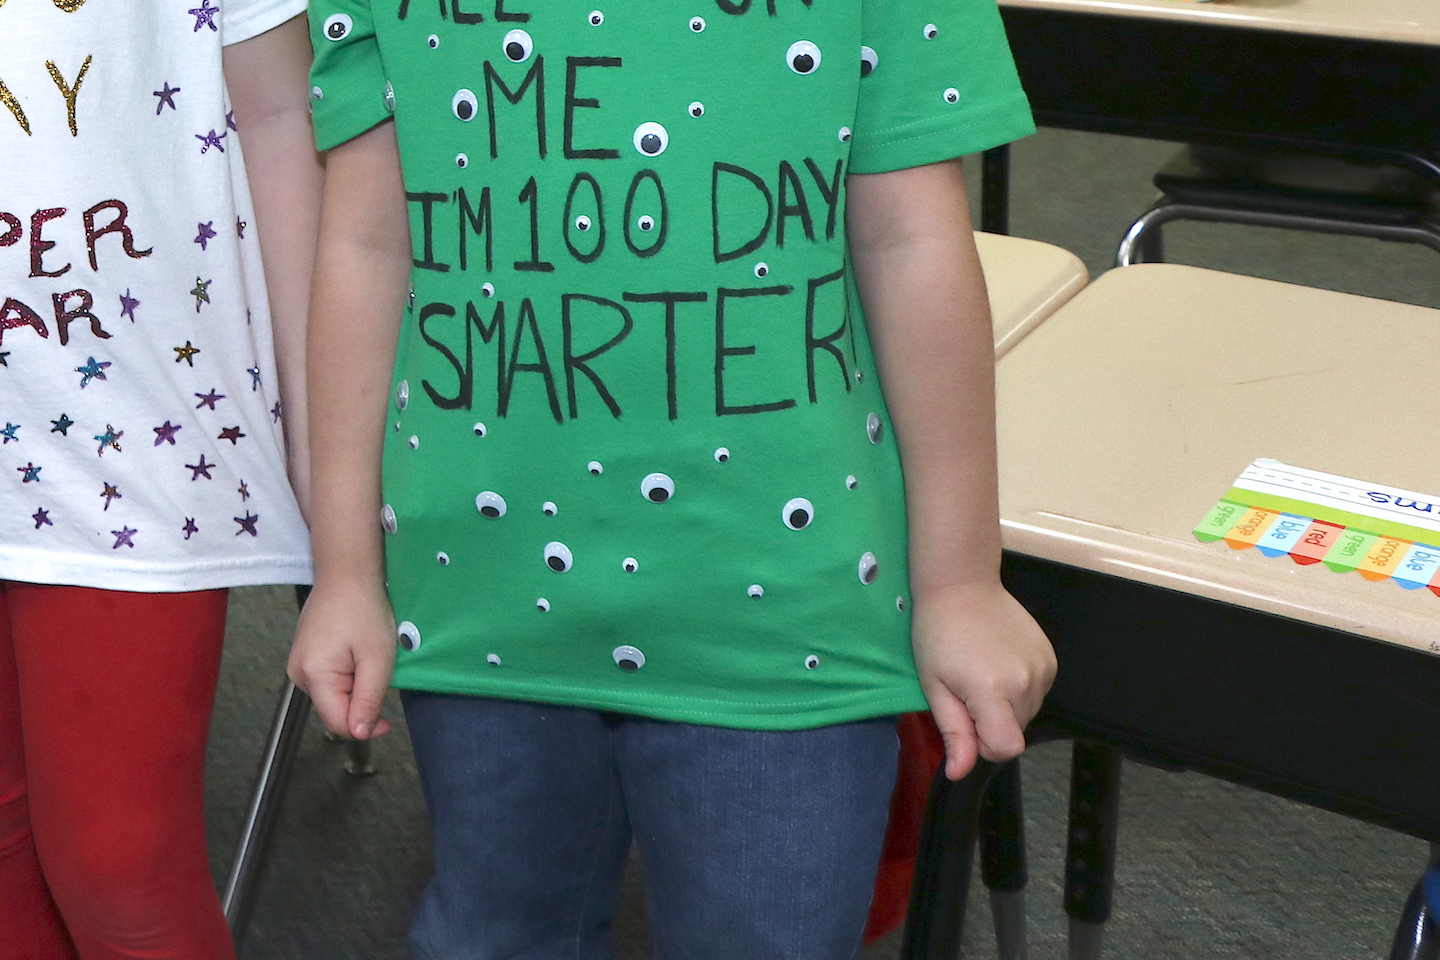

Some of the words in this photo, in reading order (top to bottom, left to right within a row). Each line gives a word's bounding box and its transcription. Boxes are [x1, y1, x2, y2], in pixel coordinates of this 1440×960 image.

[483, 53, 623, 160] ME
[513, 168, 669, 273] 100
[711, 157, 848, 265] DAY
[418, 266, 852, 424] SMARTER
[1366, 490, 1440, 514] ms
[1211, 506, 1236, 527] green
[1239, 511, 1268, 537] orange
[1271, 520, 1305, 540] blue
[1305, 529, 1329, 548] red
[1341, 535, 1366, 557] green
[1372, 540, 1400, 567] orange
[1406, 551, 1440, 571] blue
